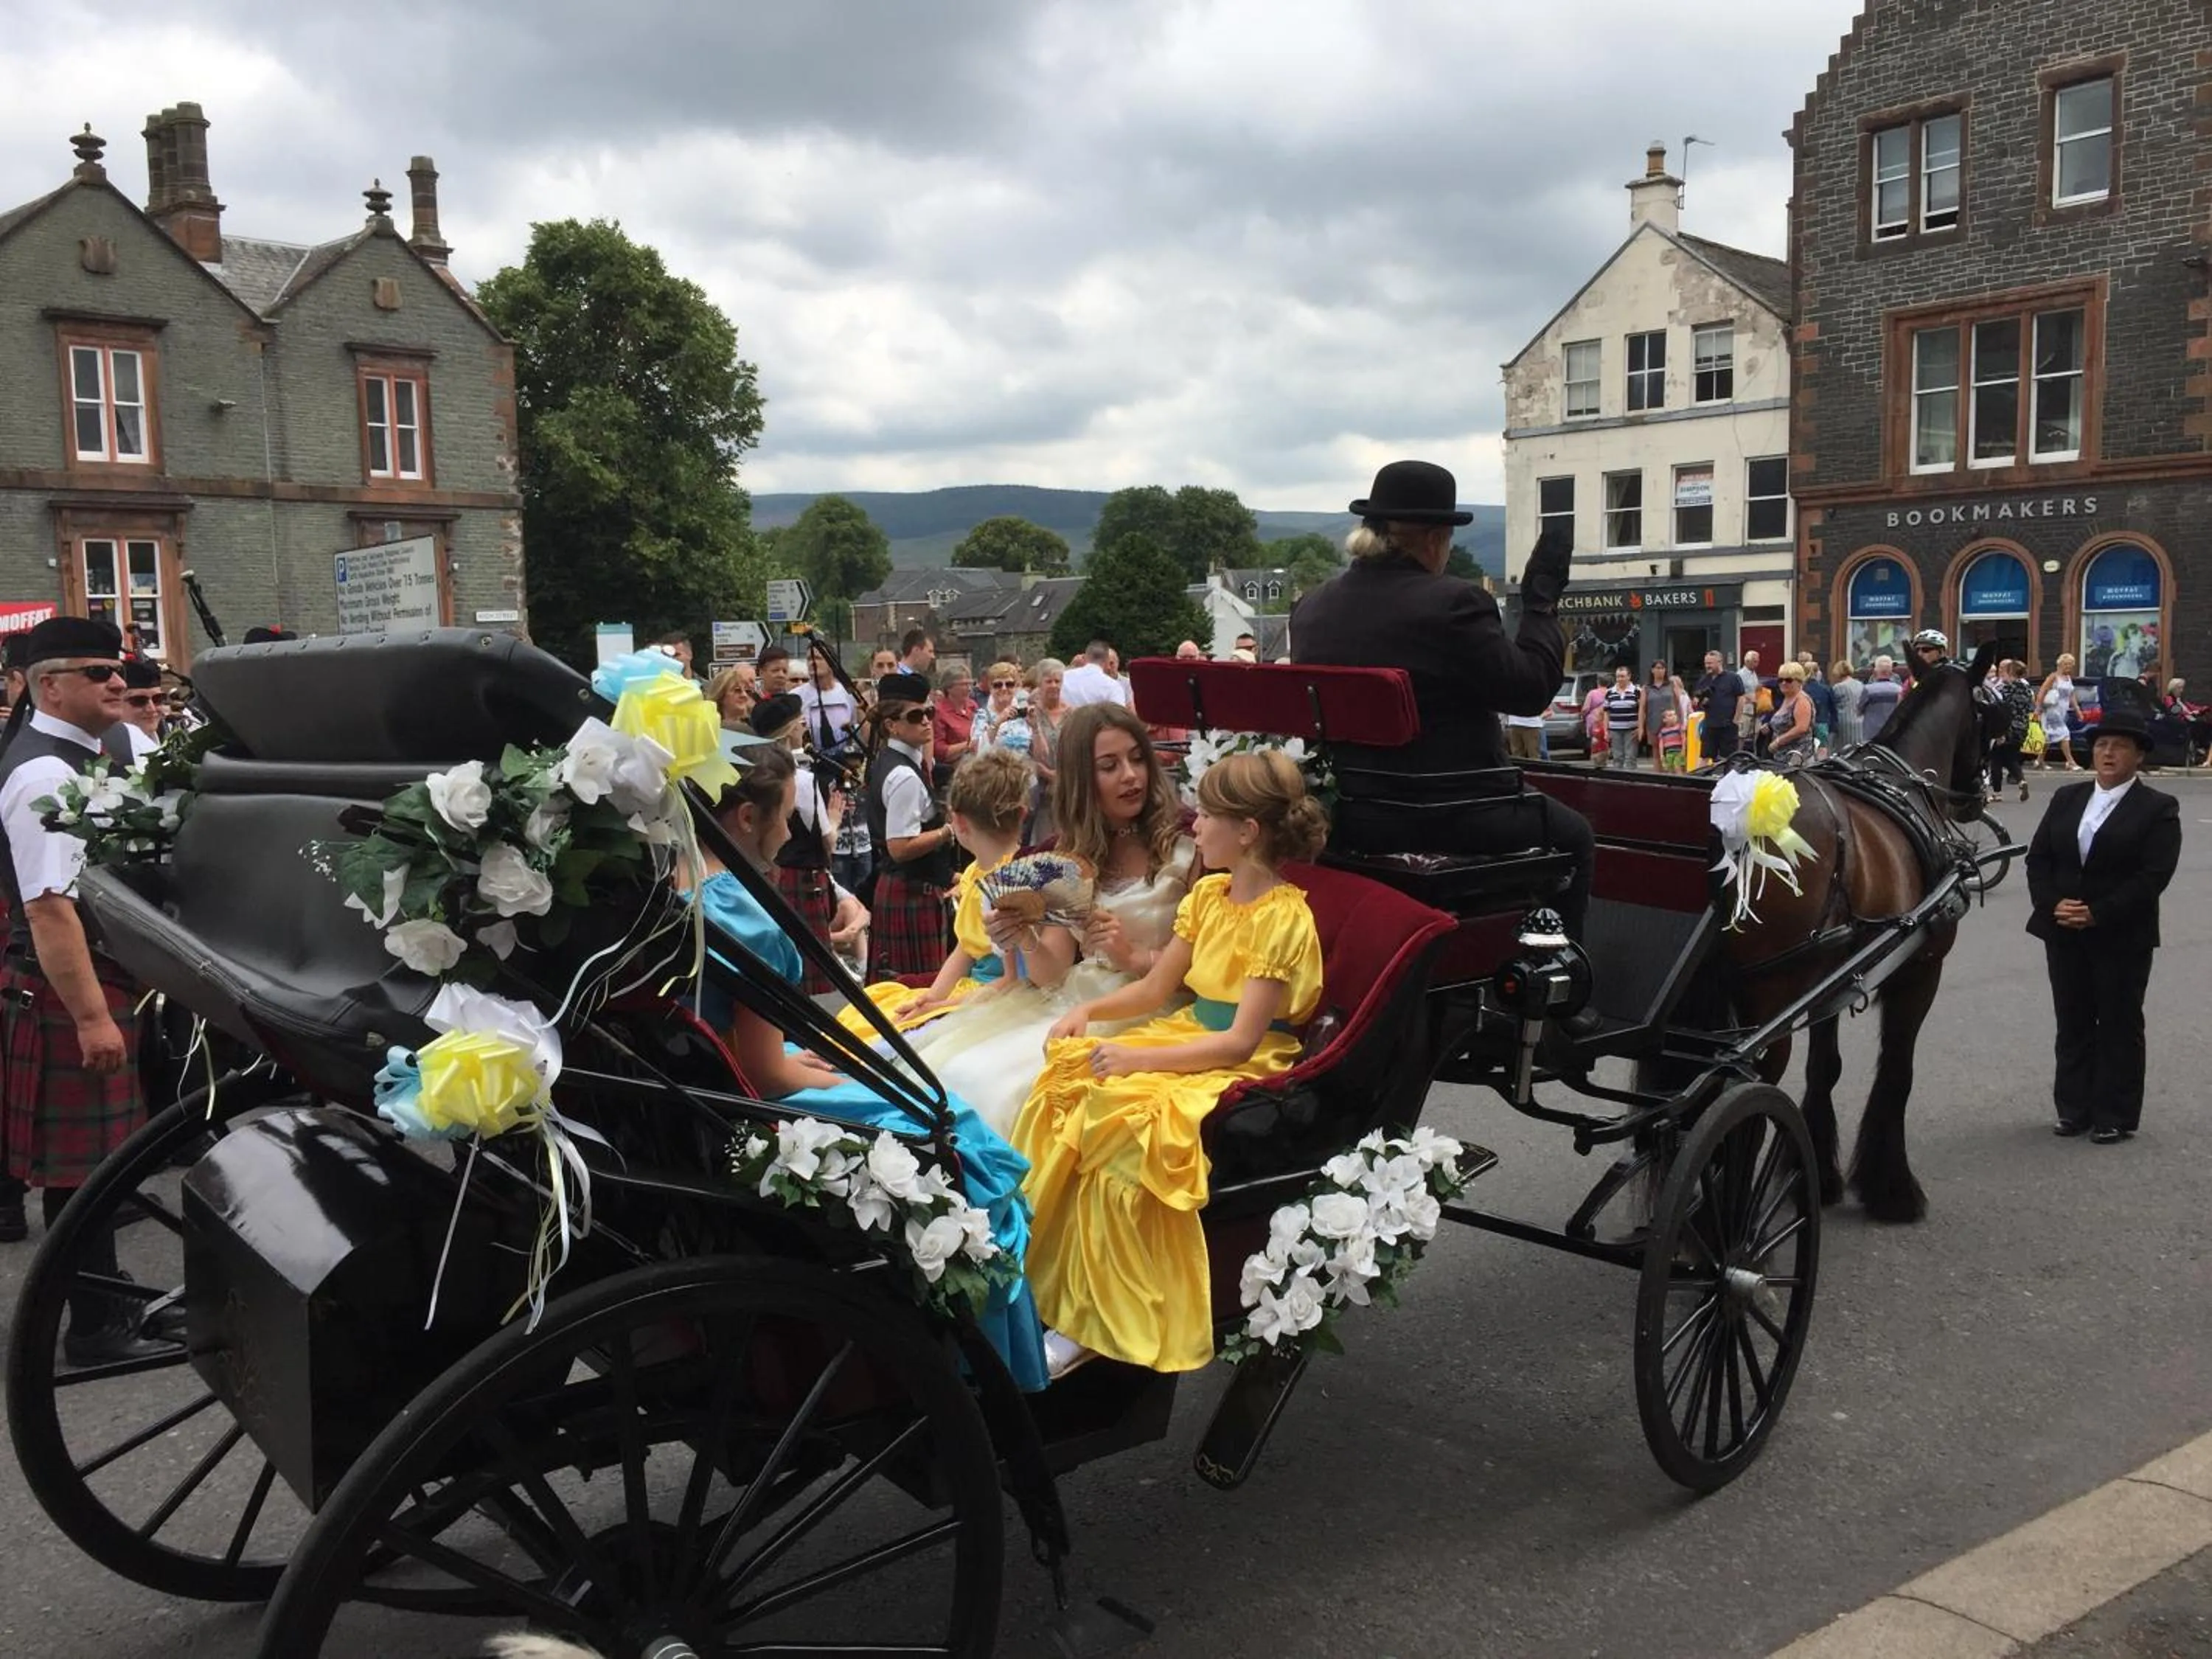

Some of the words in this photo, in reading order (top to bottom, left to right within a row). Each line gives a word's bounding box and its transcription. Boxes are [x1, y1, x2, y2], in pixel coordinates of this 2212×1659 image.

[1887, 497, 2098, 527] BOOKMAKERS
[388, 576, 402, 589] Over
[1645, 592, 1697, 605] BAKERS
[0, 607, 52, 632] MOFFAT
